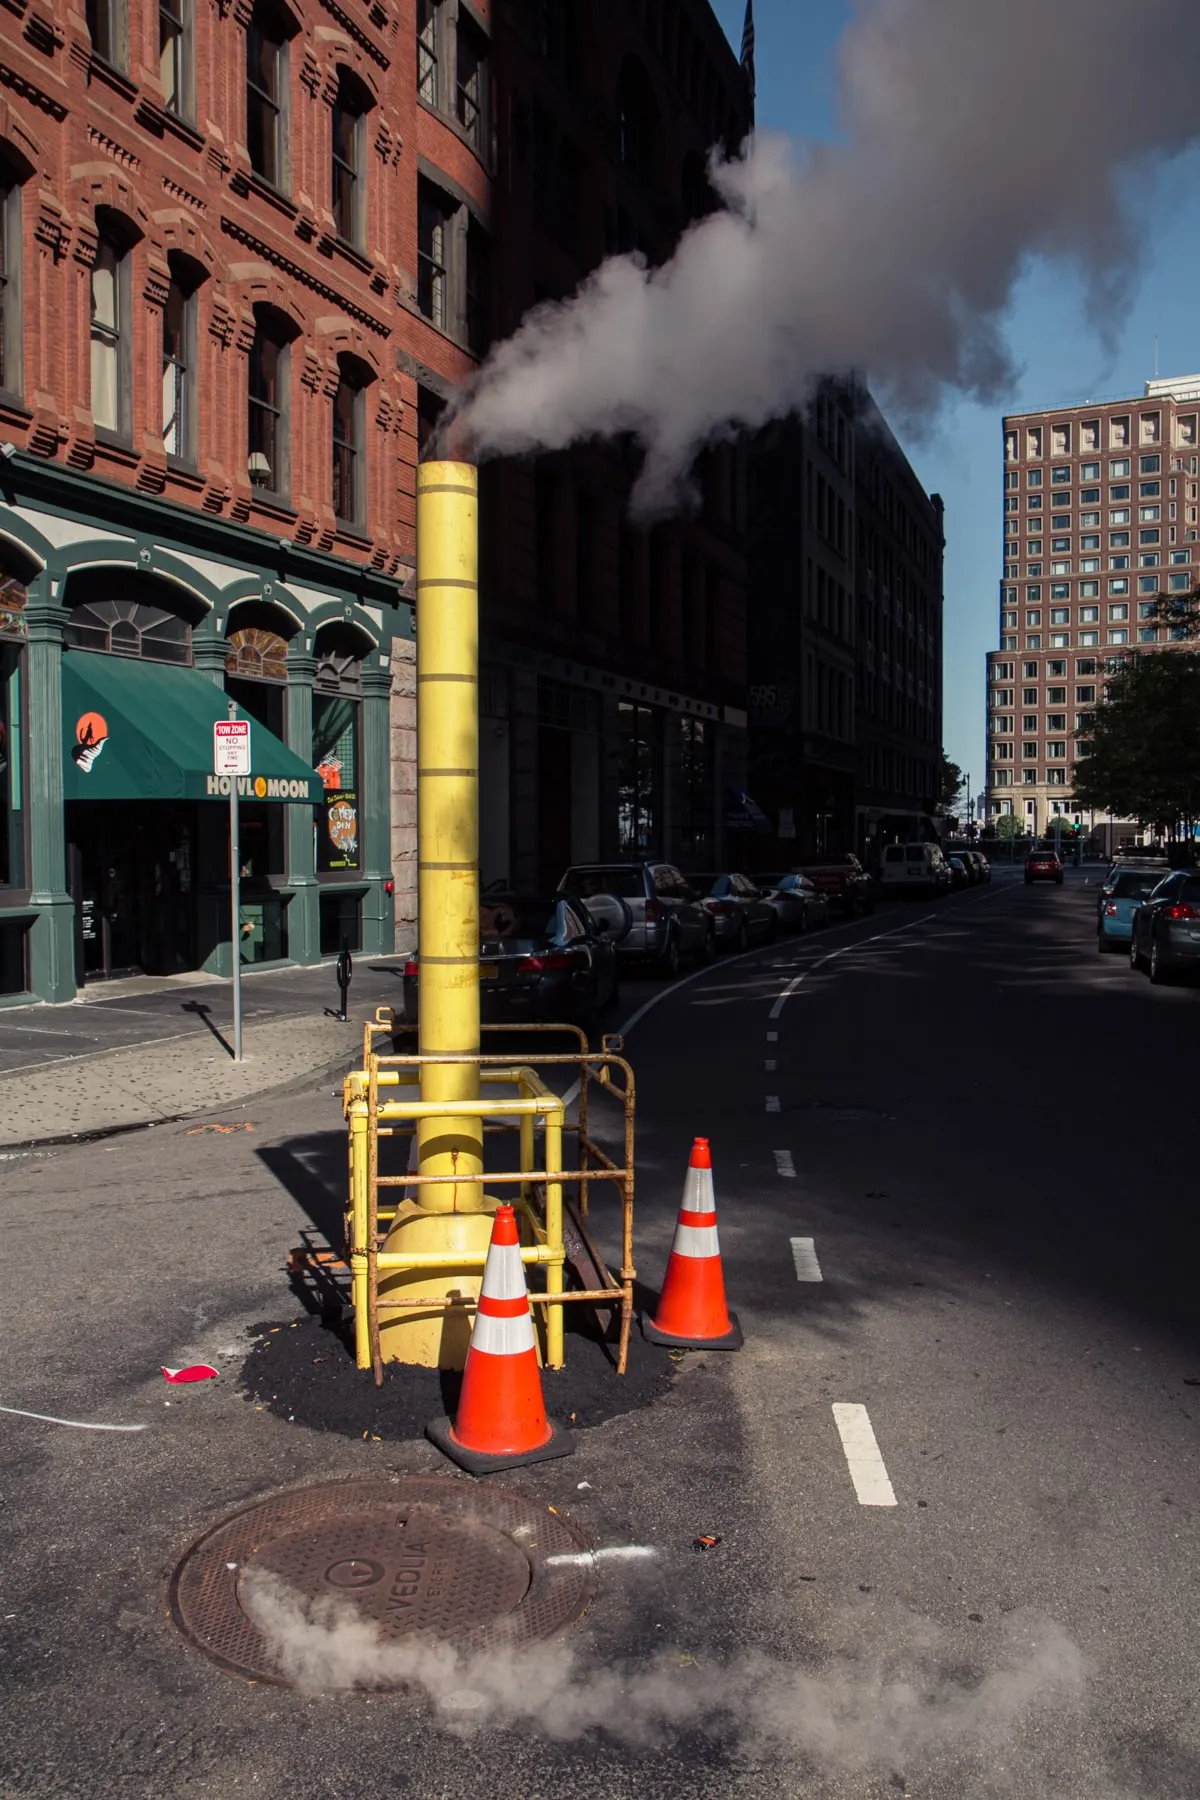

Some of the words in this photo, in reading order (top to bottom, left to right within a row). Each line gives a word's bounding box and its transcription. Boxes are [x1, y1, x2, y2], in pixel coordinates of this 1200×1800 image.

[749, 684, 776, 706] 595
[217, 725, 231, 735] TOW
[231, 724, 247, 735] ZONE
[267, 779, 309, 798] MOON
[336, 821, 351, 830] DEN
[385, 1542, 431, 1611] VEOLIA
